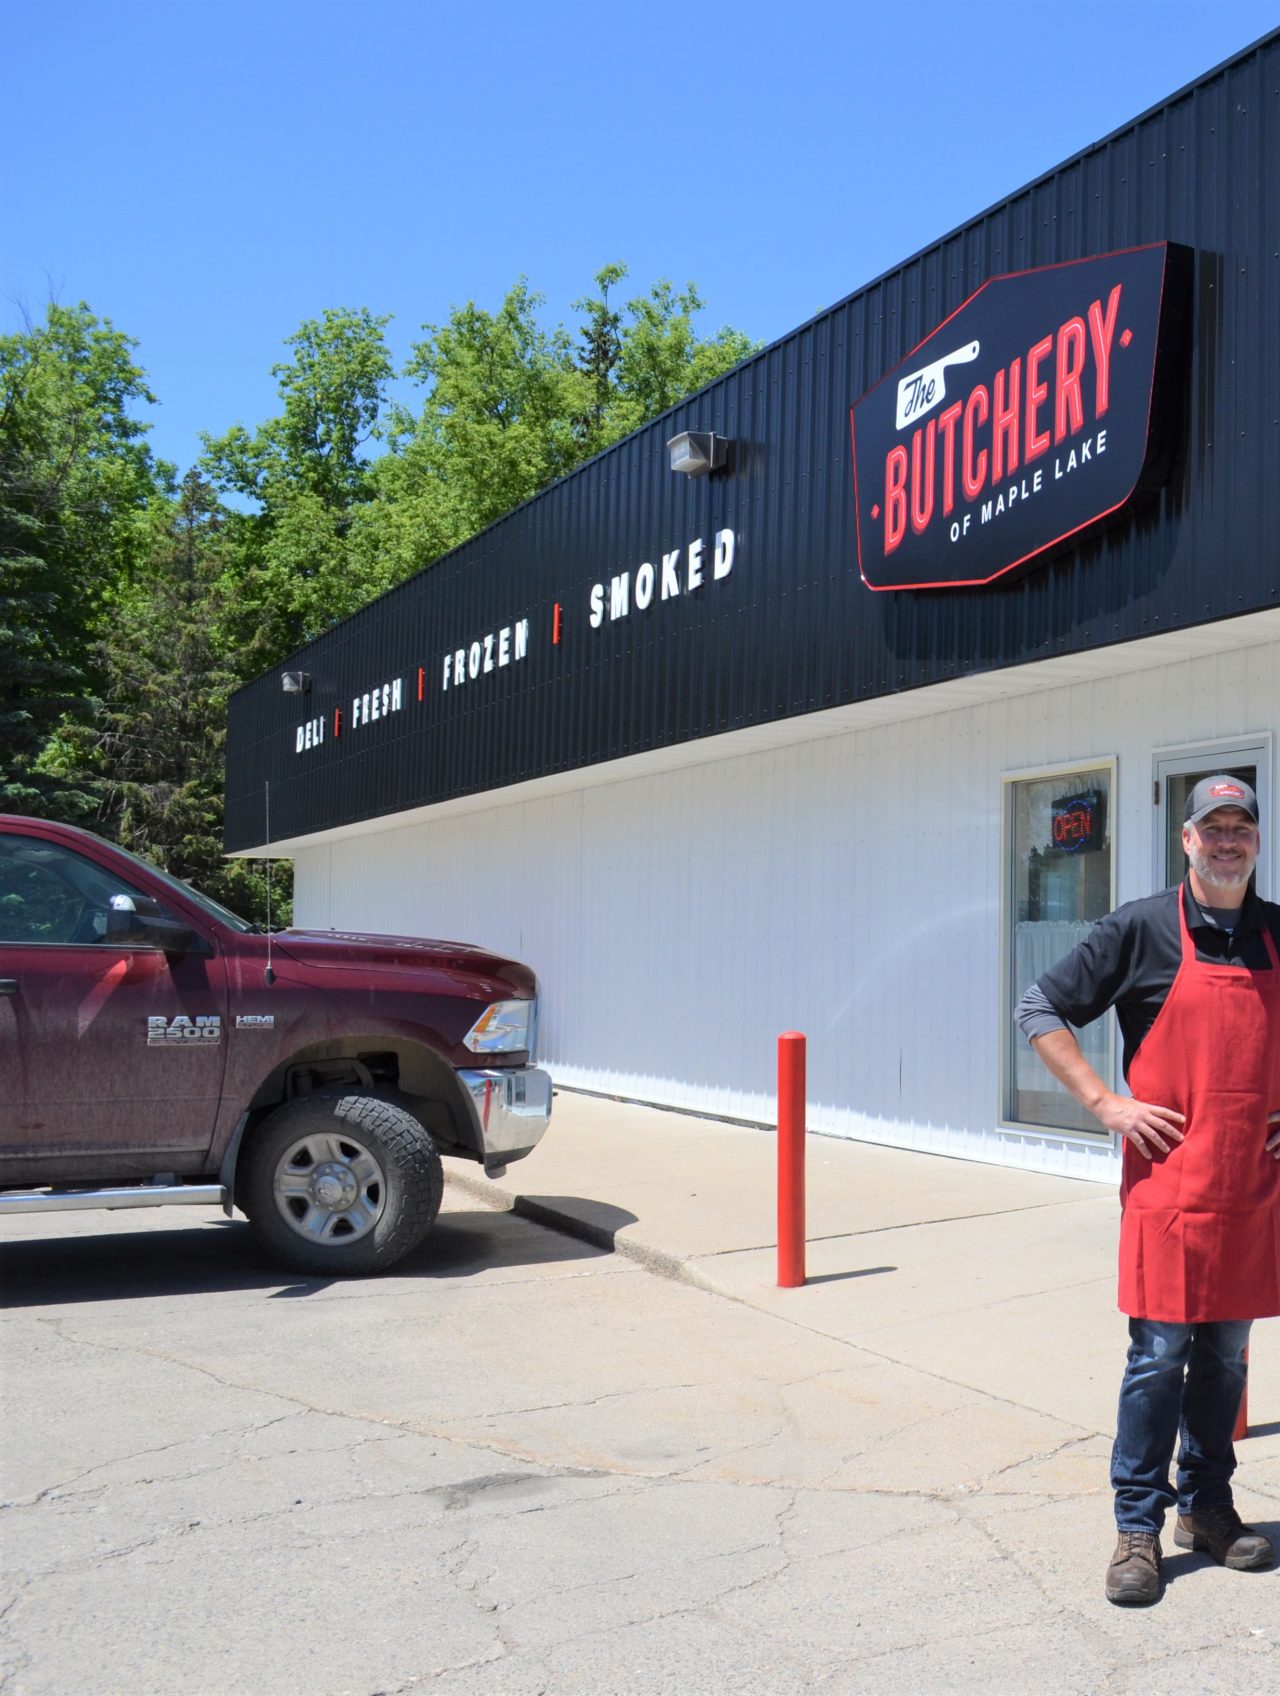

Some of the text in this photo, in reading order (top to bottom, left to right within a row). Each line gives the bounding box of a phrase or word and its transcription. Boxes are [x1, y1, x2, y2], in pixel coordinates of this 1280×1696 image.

[903, 374, 936, 418] The
[883, 283, 1122, 556] BUTCHERY
[950, 430, 1107, 542] OF MAPLE LAKE
[295, 528, 735, 753] DELI FRESH FROZEN SMOKED
[1053, 810, 1091, 841] OPEN
[148, 1016, 221, 1027] RAM
[148, 1027, 221, 1038] 2500
[237, 1015, 275, 1024] HEMI
